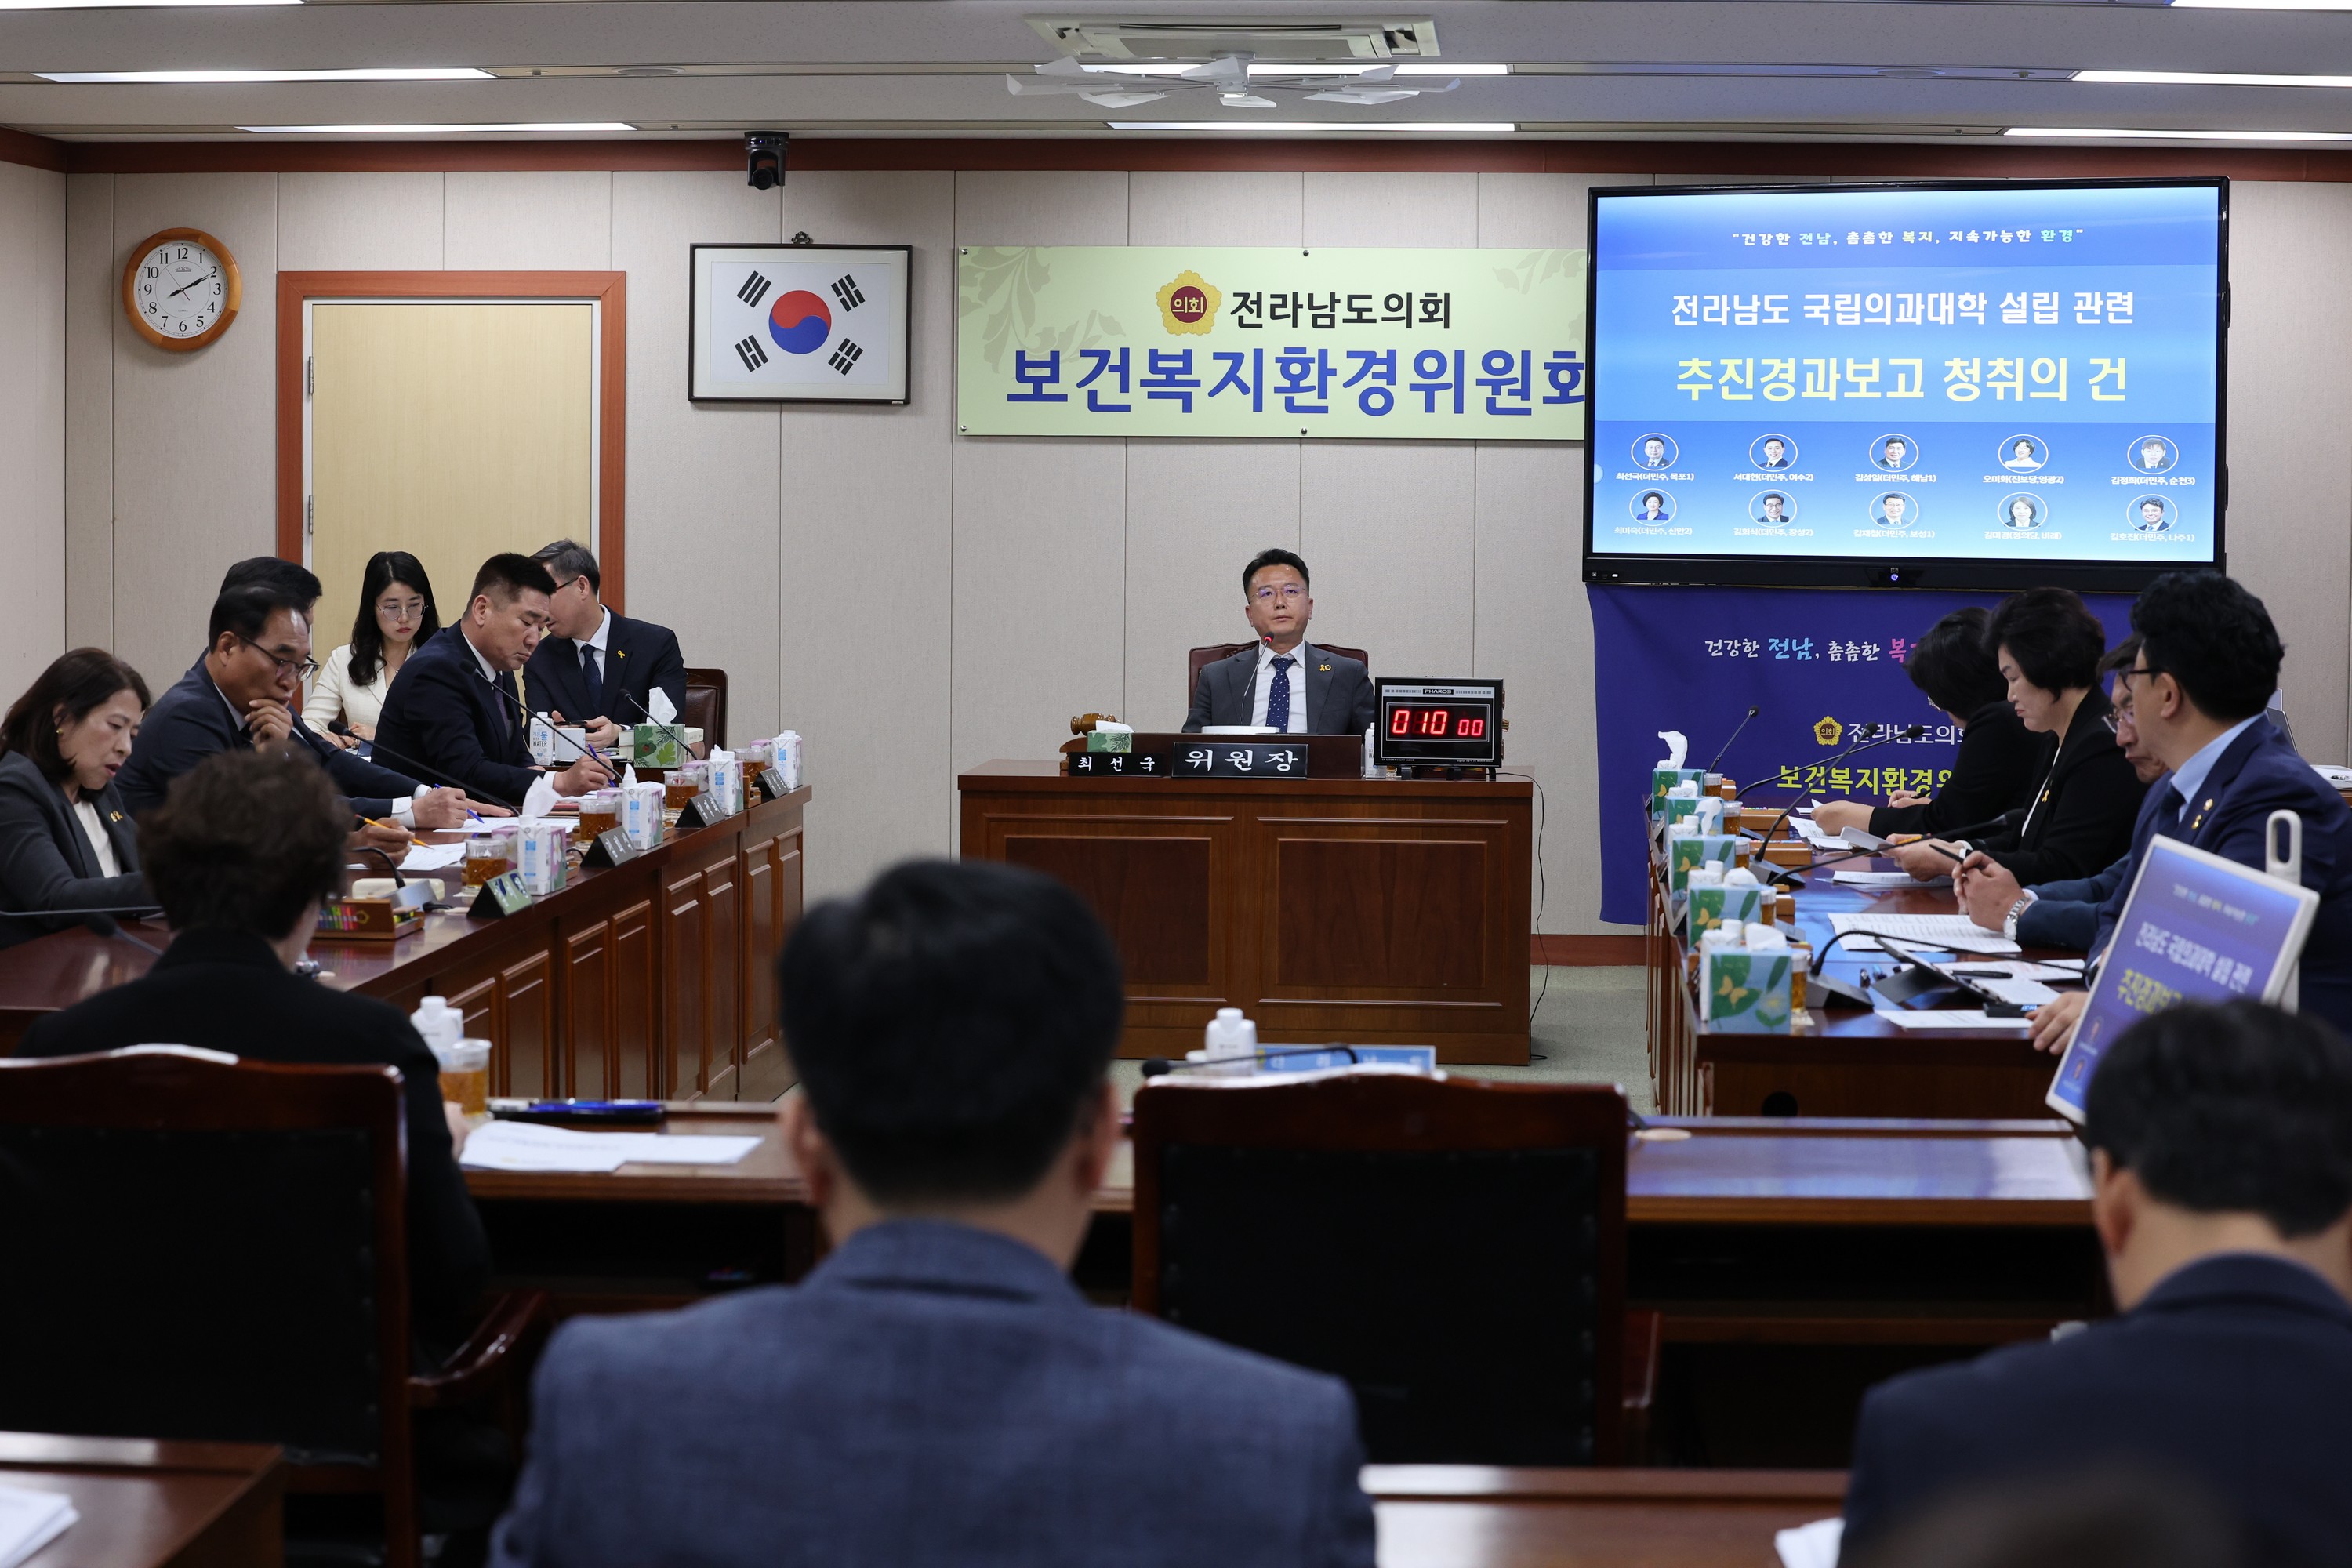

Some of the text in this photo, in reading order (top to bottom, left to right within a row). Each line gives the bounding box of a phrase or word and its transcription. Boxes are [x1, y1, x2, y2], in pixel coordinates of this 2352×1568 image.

[1800, 232, 1837, 246] 전남,
[1846, 231, 1893, 245] 촘촘한
[1901, 230, 1940, 245] 복지,
[1949, 230, 2032, 244] 지속가능한
[160, 252, 169, 264] 11
[177, 248, 188, 259] 12
[199, 252, 203, 263] 1
[147, 267, 159, 278] 10
[210, 266, 217, 278] 2
[144, 284, 152, 296] 9
[213, 283, 222, 295] 3
[149, 302, 158, 314] 8
[207, 302, 215, 313] 4
[1171, 294, 1206, 314] 의회
[1229, 290, 1452, 329] 전라남도의회
[1671, 290, 2135, 326] 전라남도 국립의과대학 설립 관련
[162, 316, 169, 328] 7
[179, 320, 187, 332] 6
[196, 316, 204, 328] 5
[1676, 356, 2127, 402] 추진경과보고 청취의 건
[1704, 637, 1918, 663] 건강한 전남, 촘촘한 복
[1392, 710, 1483, 736] 010 00
[1185, 749, 1299, 772] 위원장
